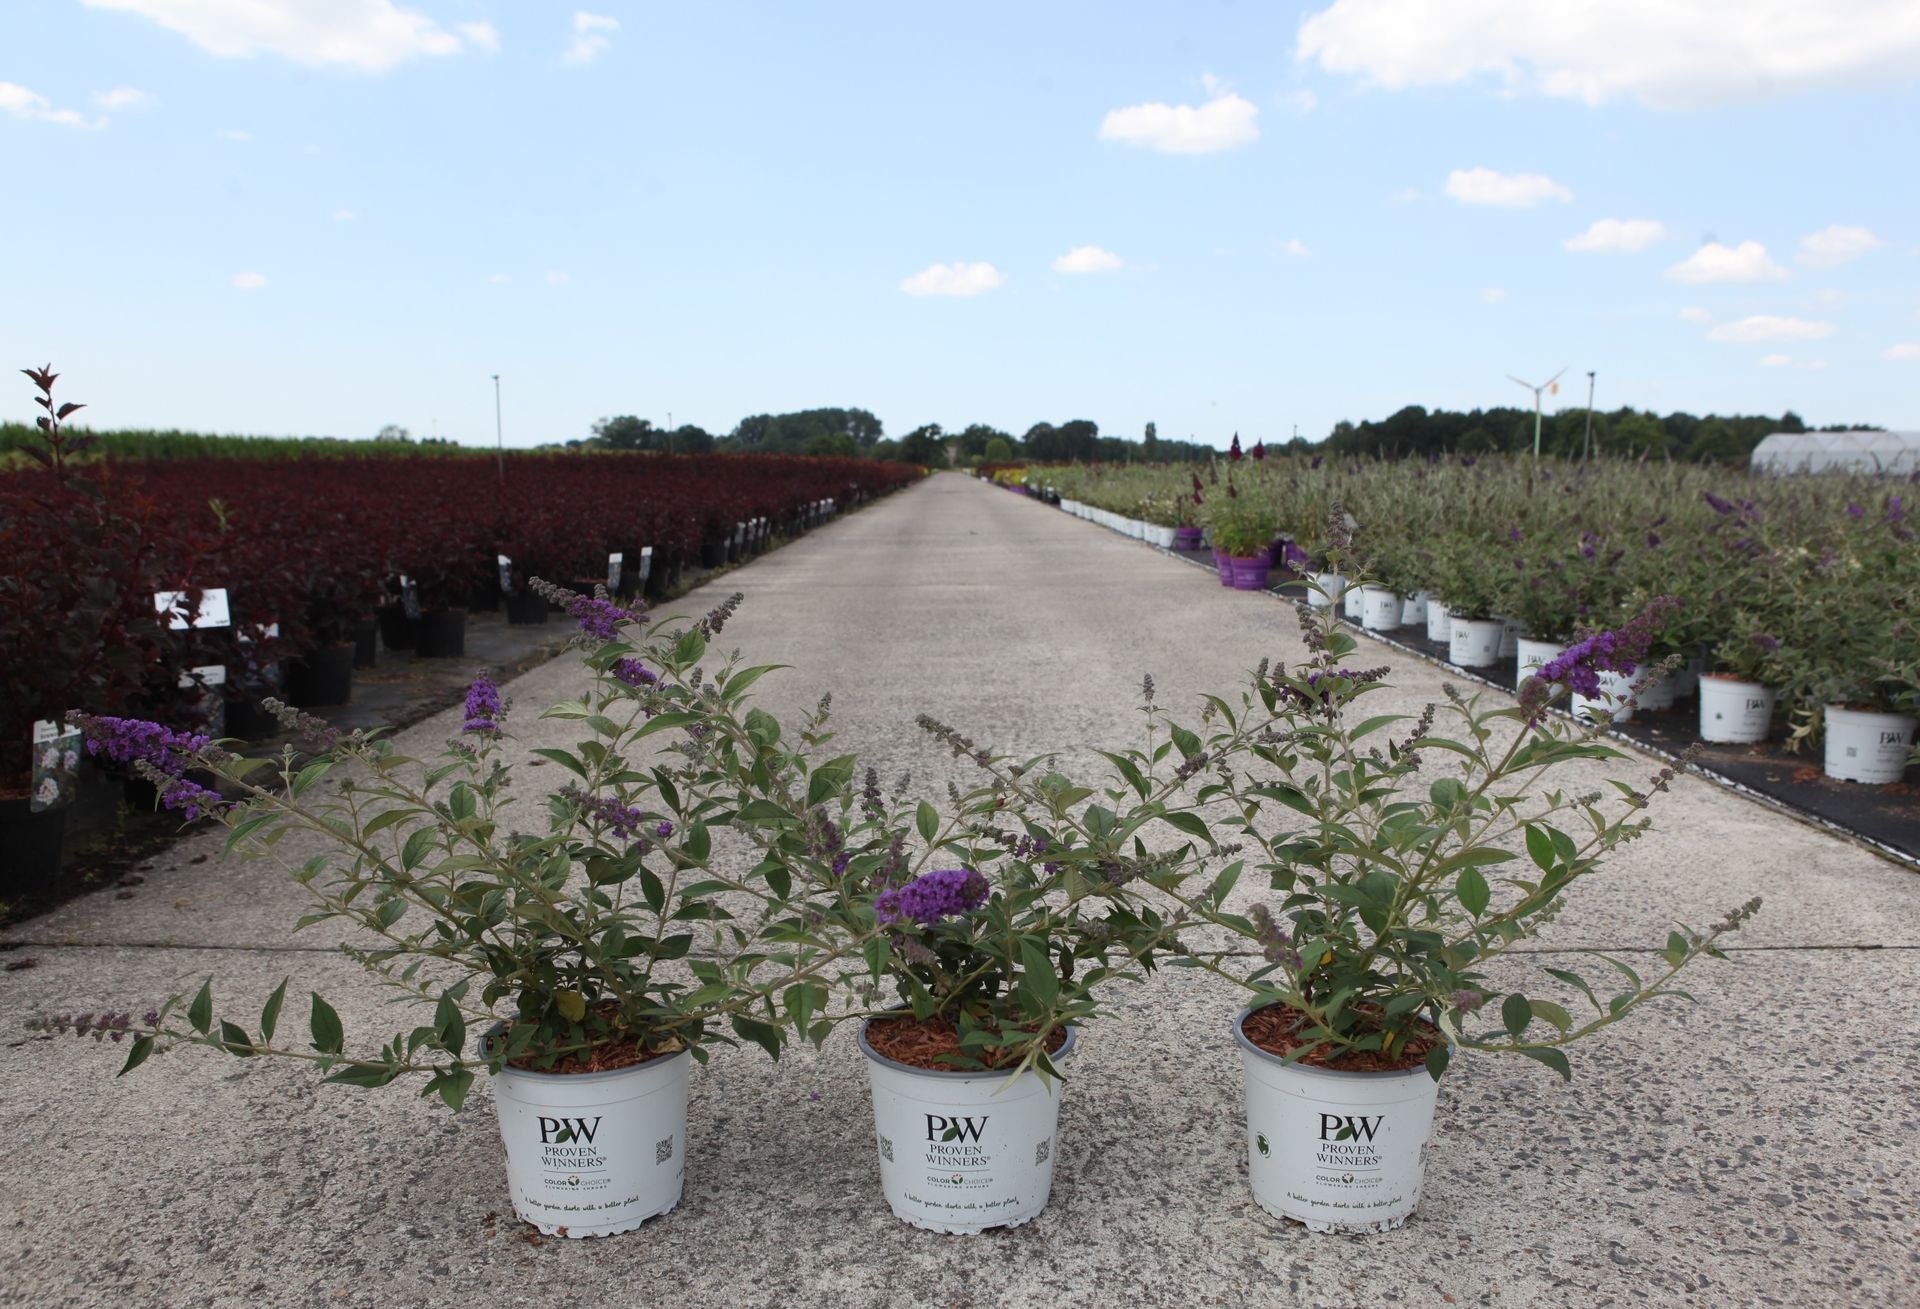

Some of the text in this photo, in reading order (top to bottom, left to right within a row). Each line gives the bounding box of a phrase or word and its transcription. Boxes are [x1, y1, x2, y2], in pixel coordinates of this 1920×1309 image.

[1880, 732, 1904, 744] PW
[536, 1116, 603, 1144] PW
[924, 1113, 990, 1144] PW
[1317, 1112, 1386, 1144] PW
[544, 1146, 597, 1157] PROVEN
[930, 1144, 982, 1155] PROVEN
[1322, 1143, 1376, 1155] PROVEN
[544, 1178, 567, 1186] COLOR
[926, 1176, 950, 1184] COLOR
[1315, 1174, 1340, 1184] COLOR
[604, 1200, 621, 1209] better
[985, 1200, 1001, 1208] better
[1373, 1200, 1388, 1208] better
